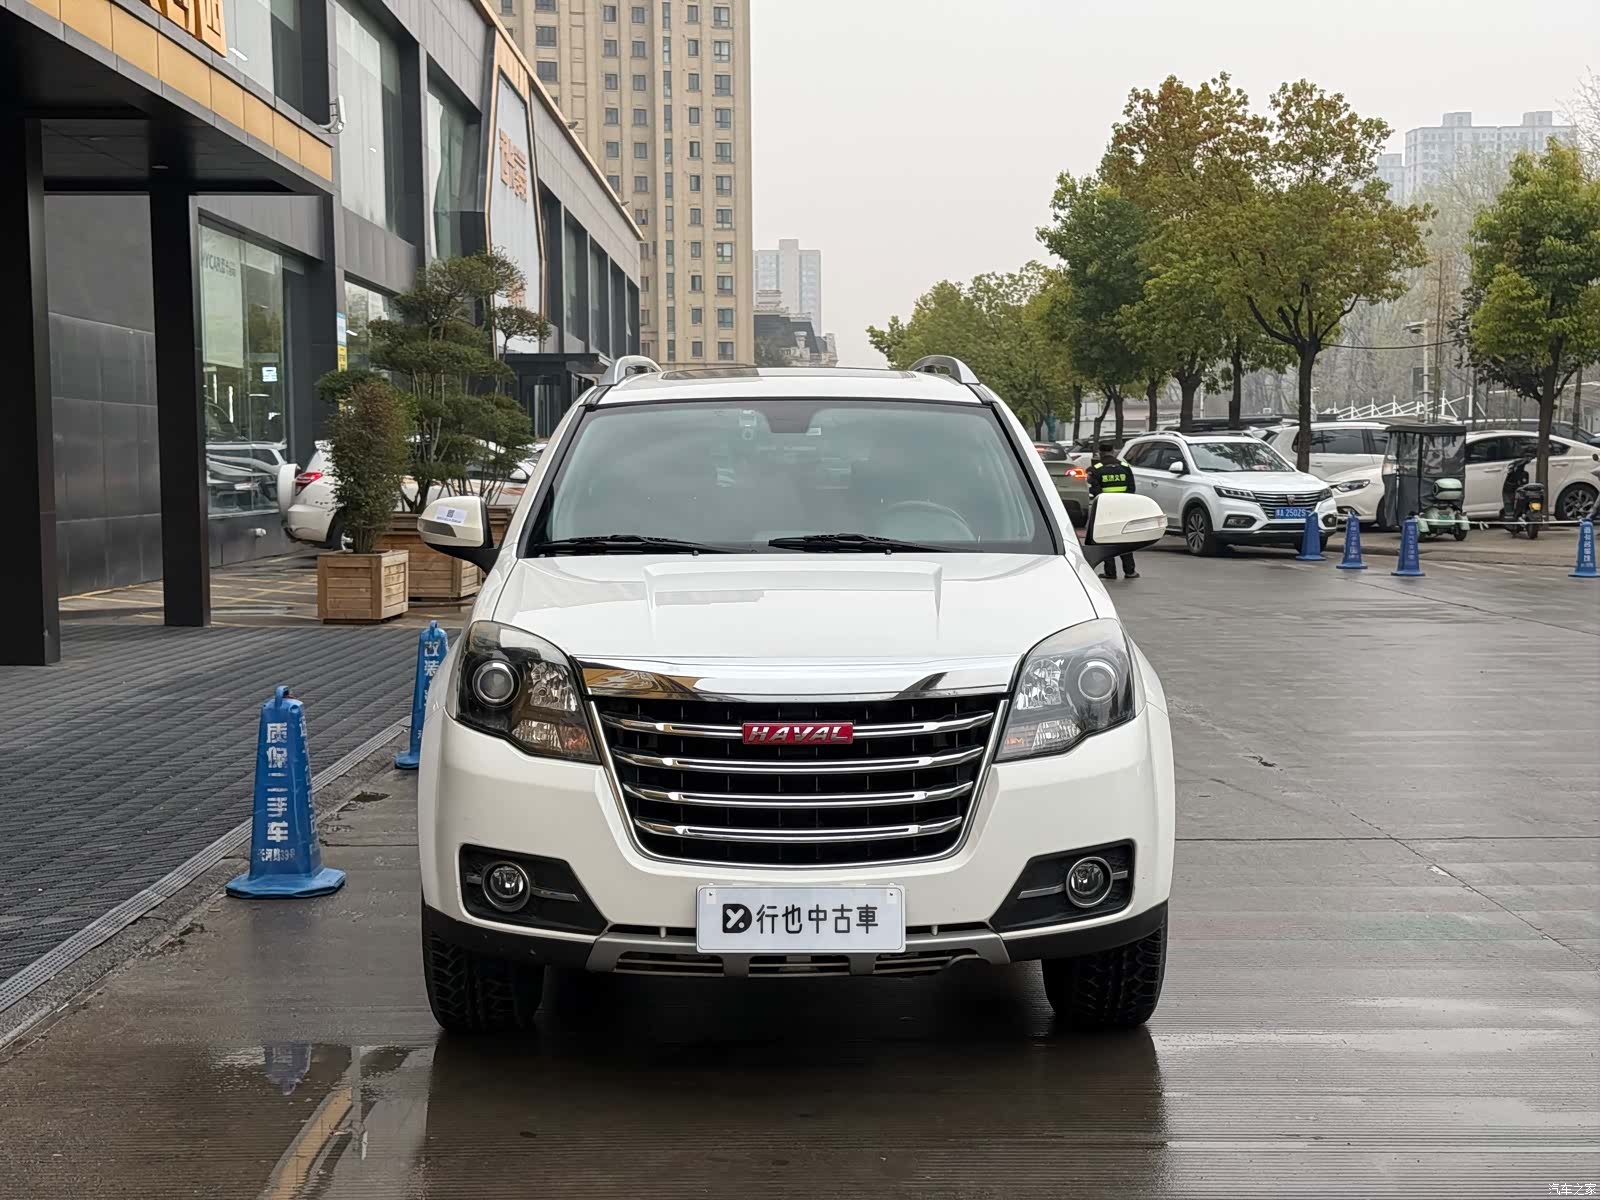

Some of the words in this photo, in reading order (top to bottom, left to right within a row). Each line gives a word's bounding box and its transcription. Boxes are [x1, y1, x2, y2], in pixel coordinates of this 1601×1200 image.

[748, 726, 849, 741] HAVAL
[266, 722, 289, 842] 质保二手车
[756, 904, 879, 934] 行也中古車
